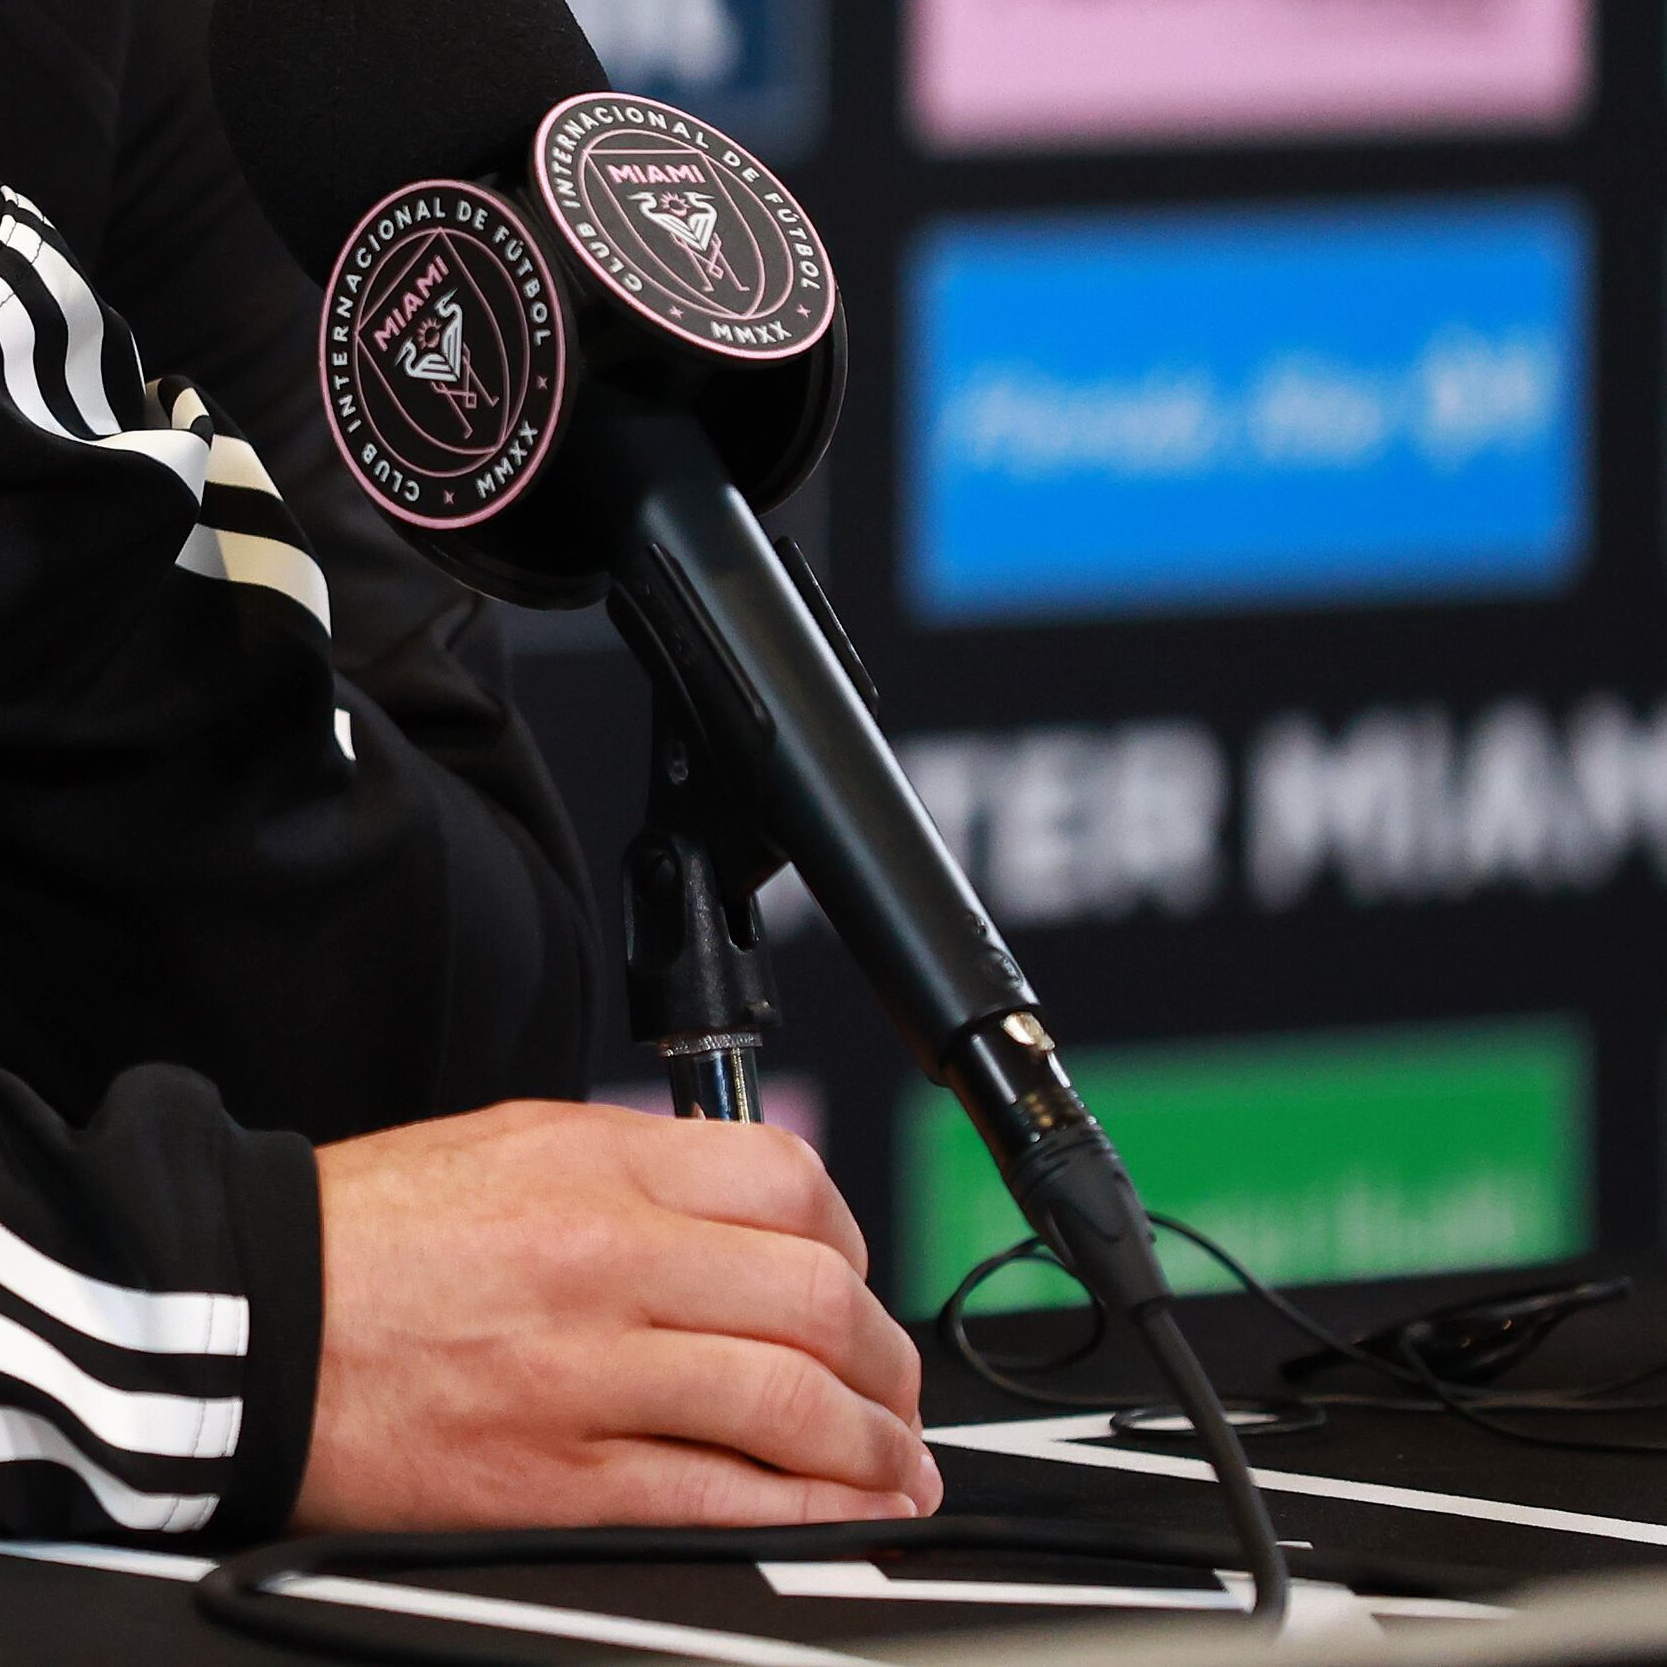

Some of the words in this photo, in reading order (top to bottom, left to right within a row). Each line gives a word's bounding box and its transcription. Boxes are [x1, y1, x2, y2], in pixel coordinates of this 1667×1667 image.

[551, 105, 710, 210] INTERNACIONAL
[607, 163, 707, 184] MIAMI
[721, 149, 761, 184] DE
[456, 199, 489, 231] DE
[765, 191, 821, 291] FÚTBOL
[491, 224, 552, 347] FÚTBOL
[576, 221, 643, 292] CLUB
[331, 197, 447, 435] INTERNACIONAL
[373, 253, 451, 352] MIAMI
[710, 320, 792, 345] MMXX
[361, 442, 421, 502] CLUB
[474, 419, 539, 500] MMXX
